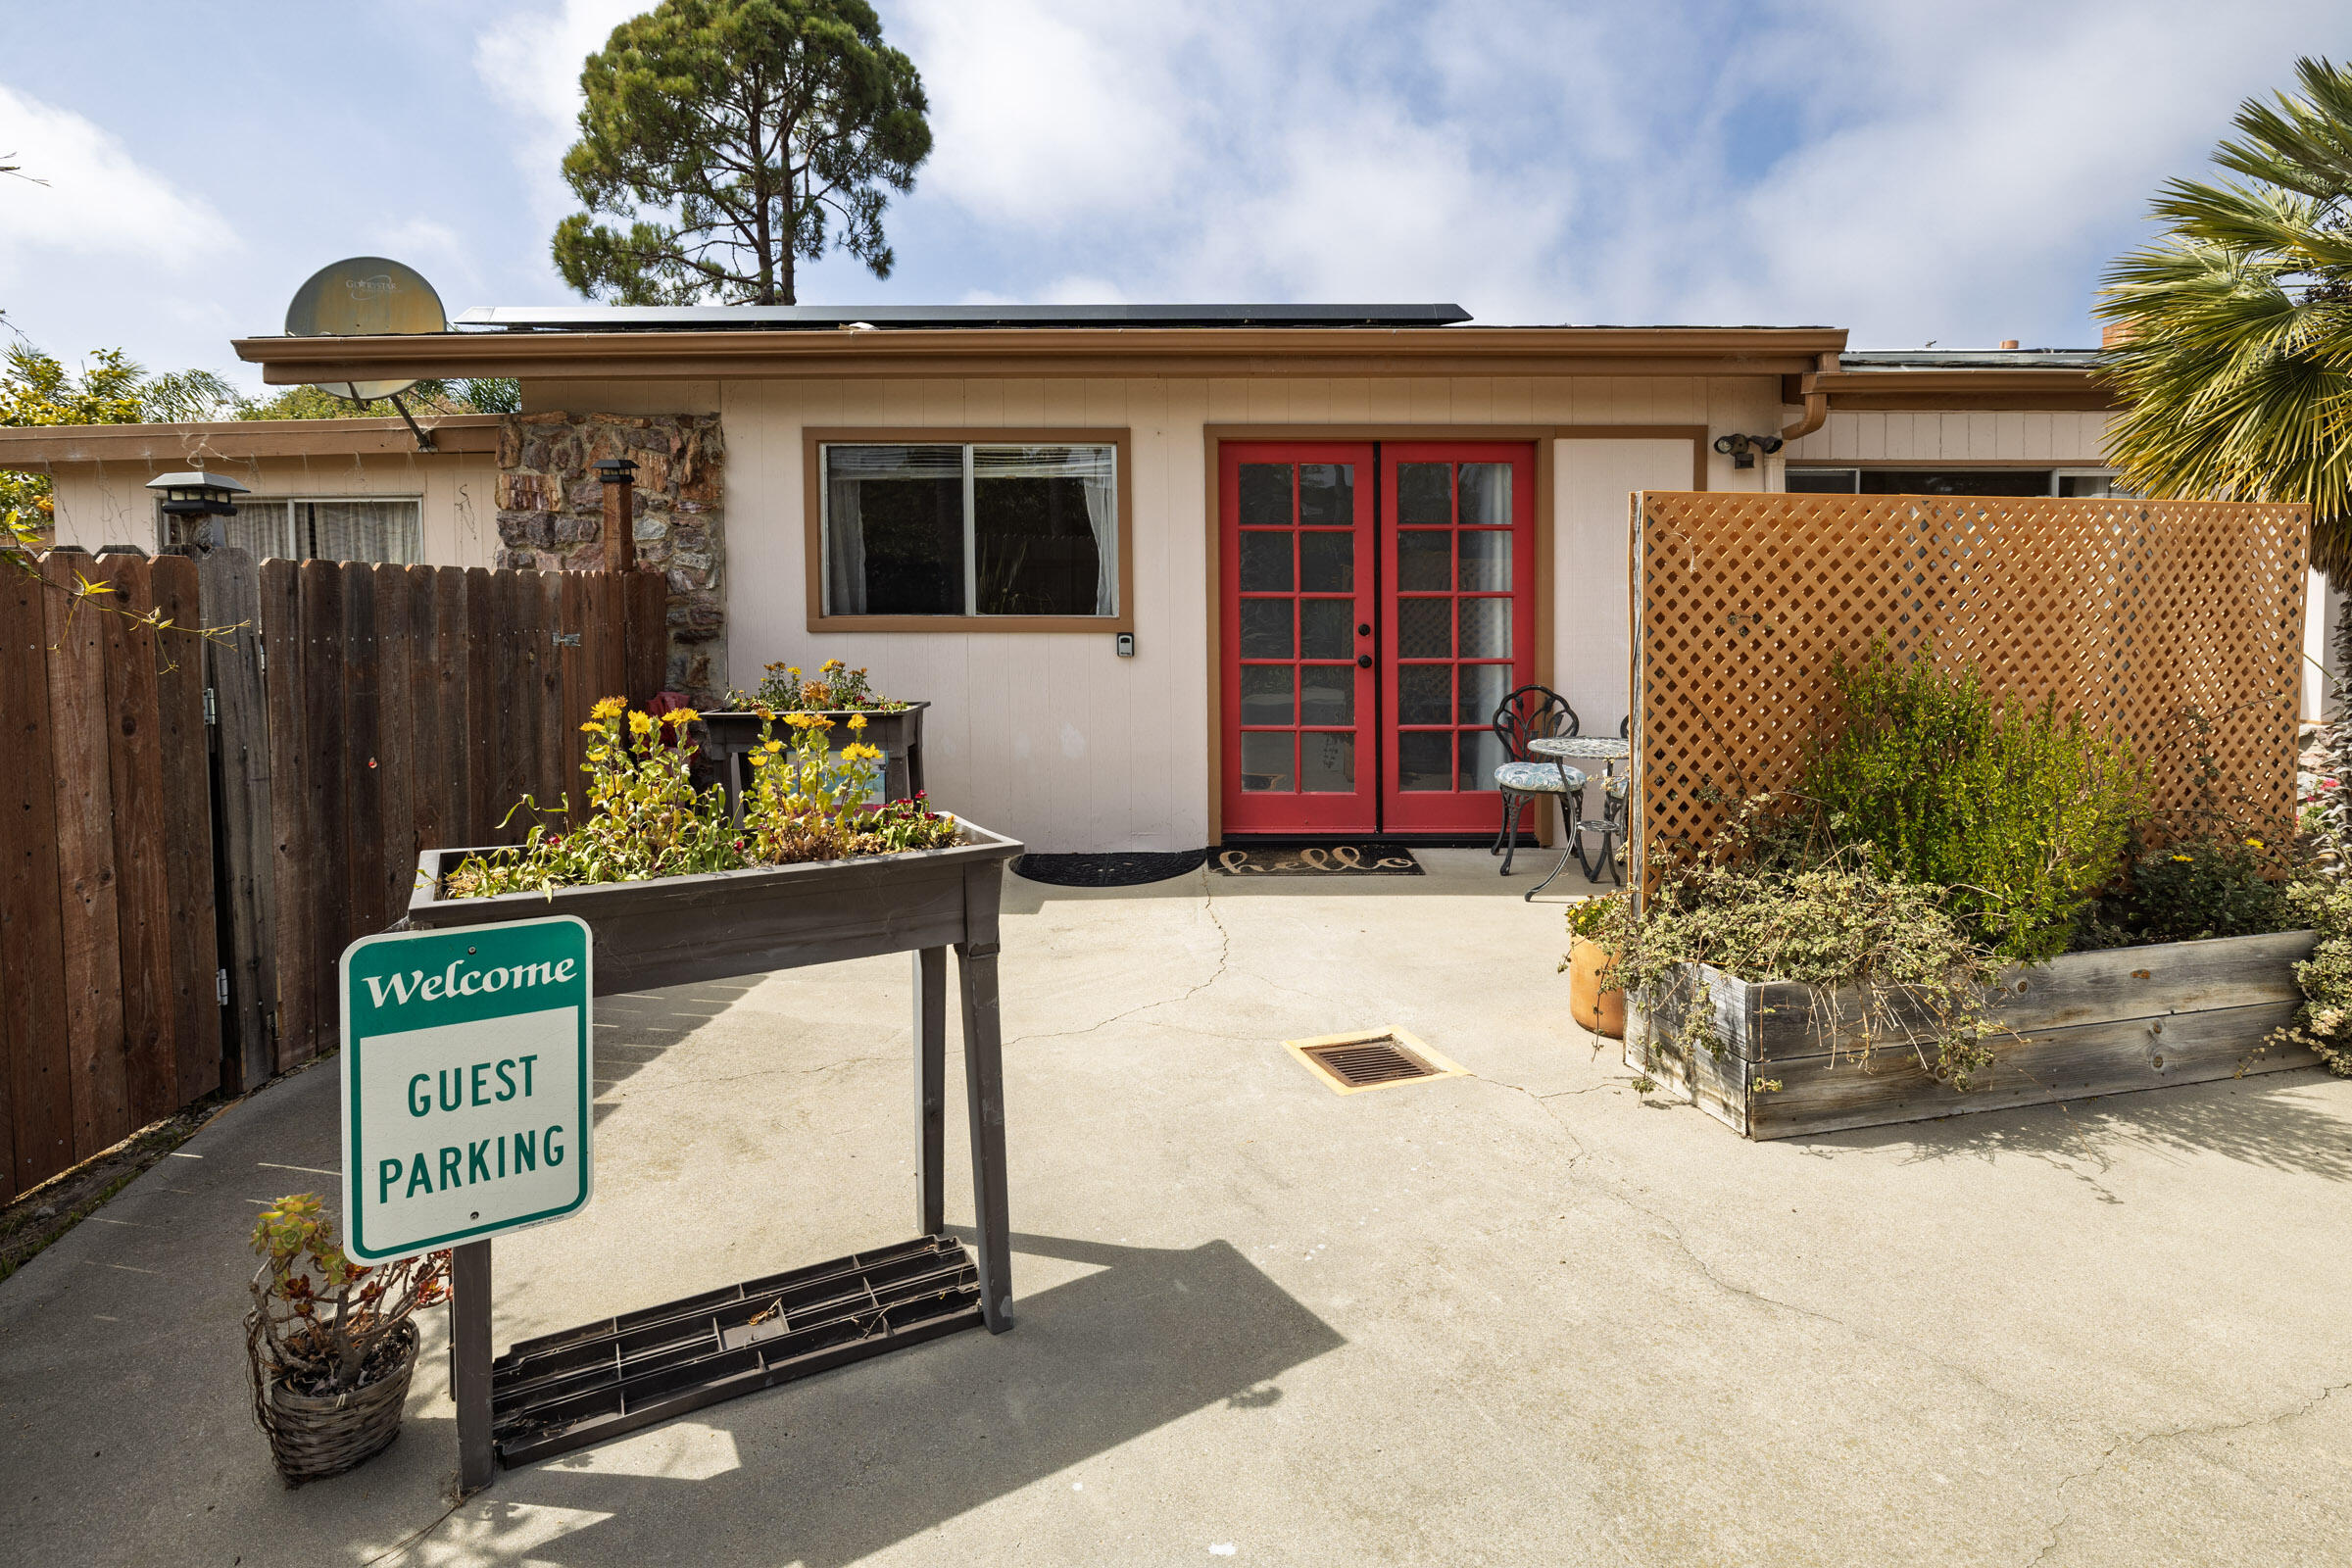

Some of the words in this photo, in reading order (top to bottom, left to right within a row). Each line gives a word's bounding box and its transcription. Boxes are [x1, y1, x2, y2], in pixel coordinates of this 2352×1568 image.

[1211, 846, 1416, 873] hello
[362, 957, 577, 1008] Welcome
[408, 1054, 538, 1117] GUEST
[379, 1125, 564, 1203] PARKING
